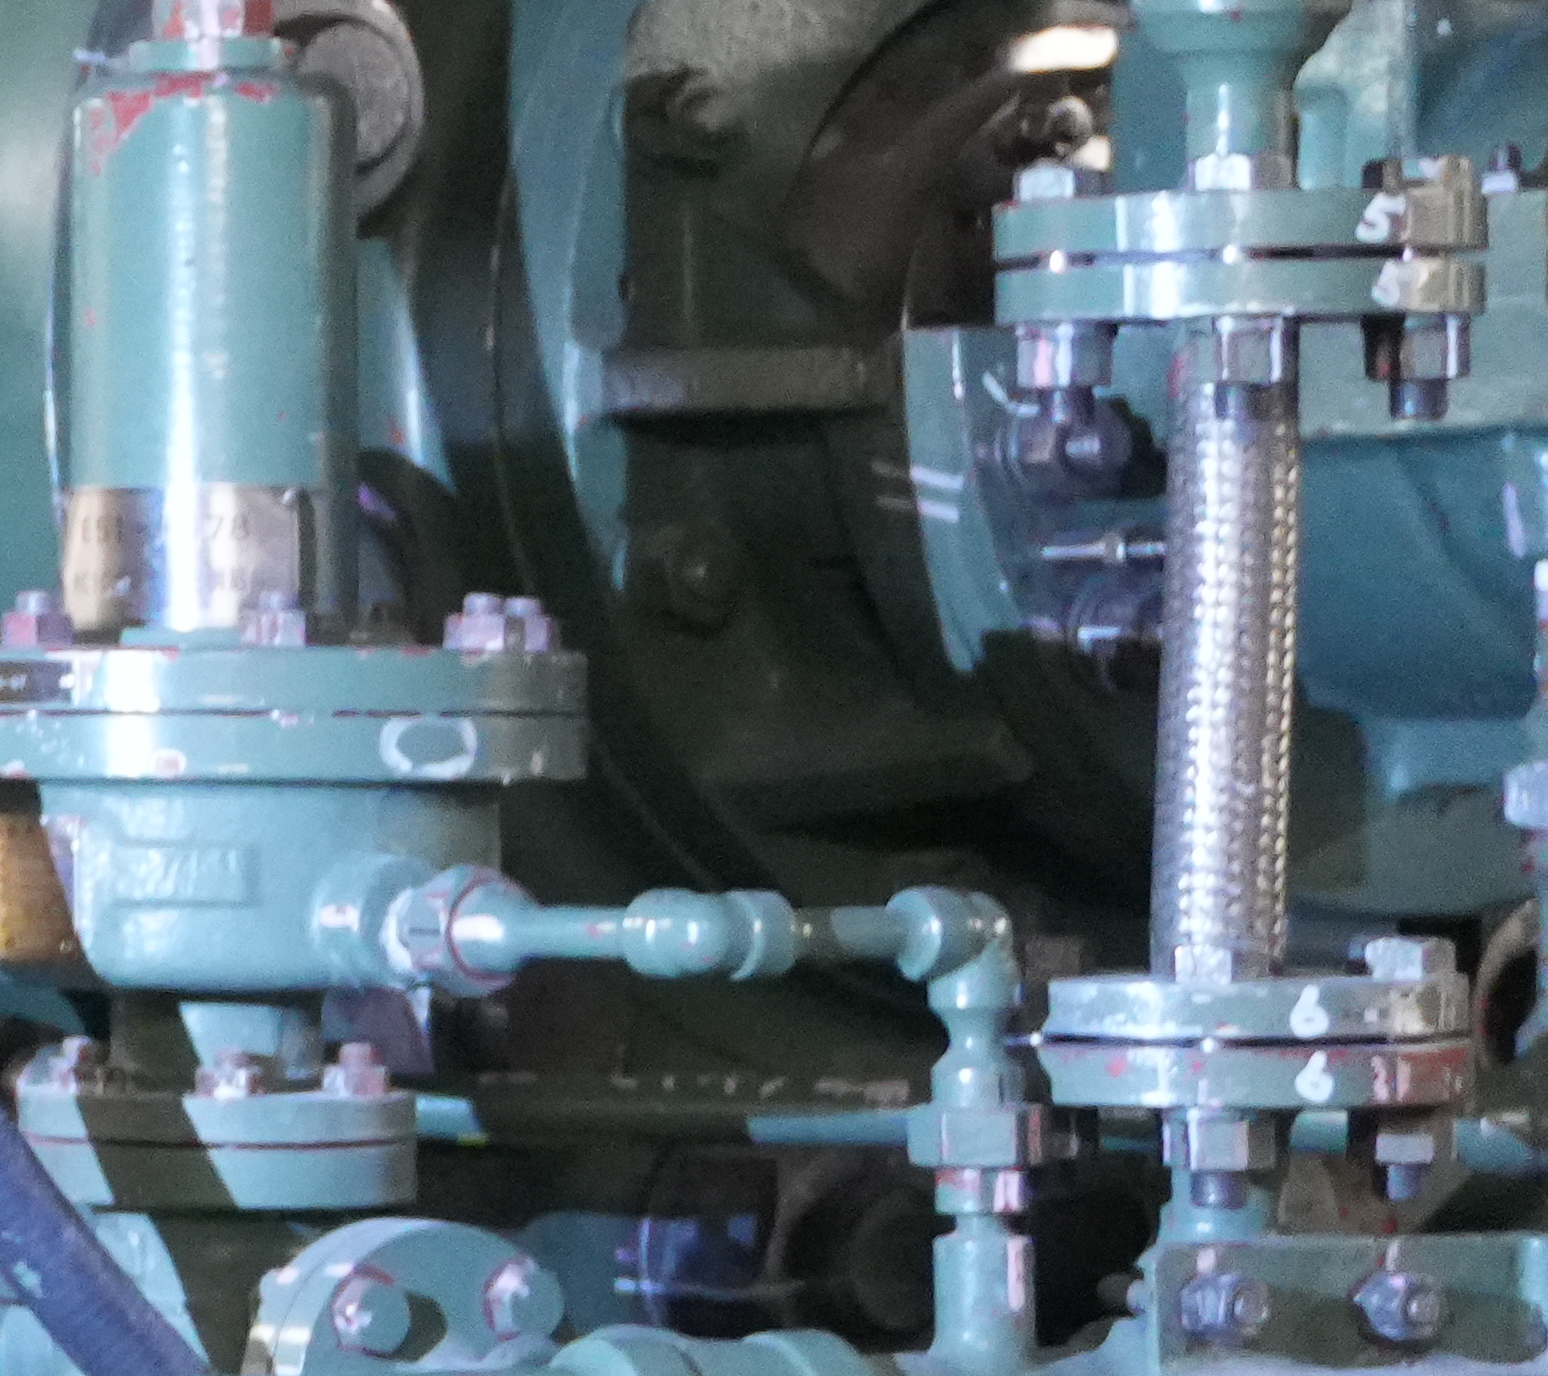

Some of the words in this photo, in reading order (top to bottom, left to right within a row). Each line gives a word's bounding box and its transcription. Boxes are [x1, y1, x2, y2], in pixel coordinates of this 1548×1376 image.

[1355, 192, 1406, 244] 5
[1289, 984, 1330, 1038] 6
[1294, 1050, 1335, 1103] 6
